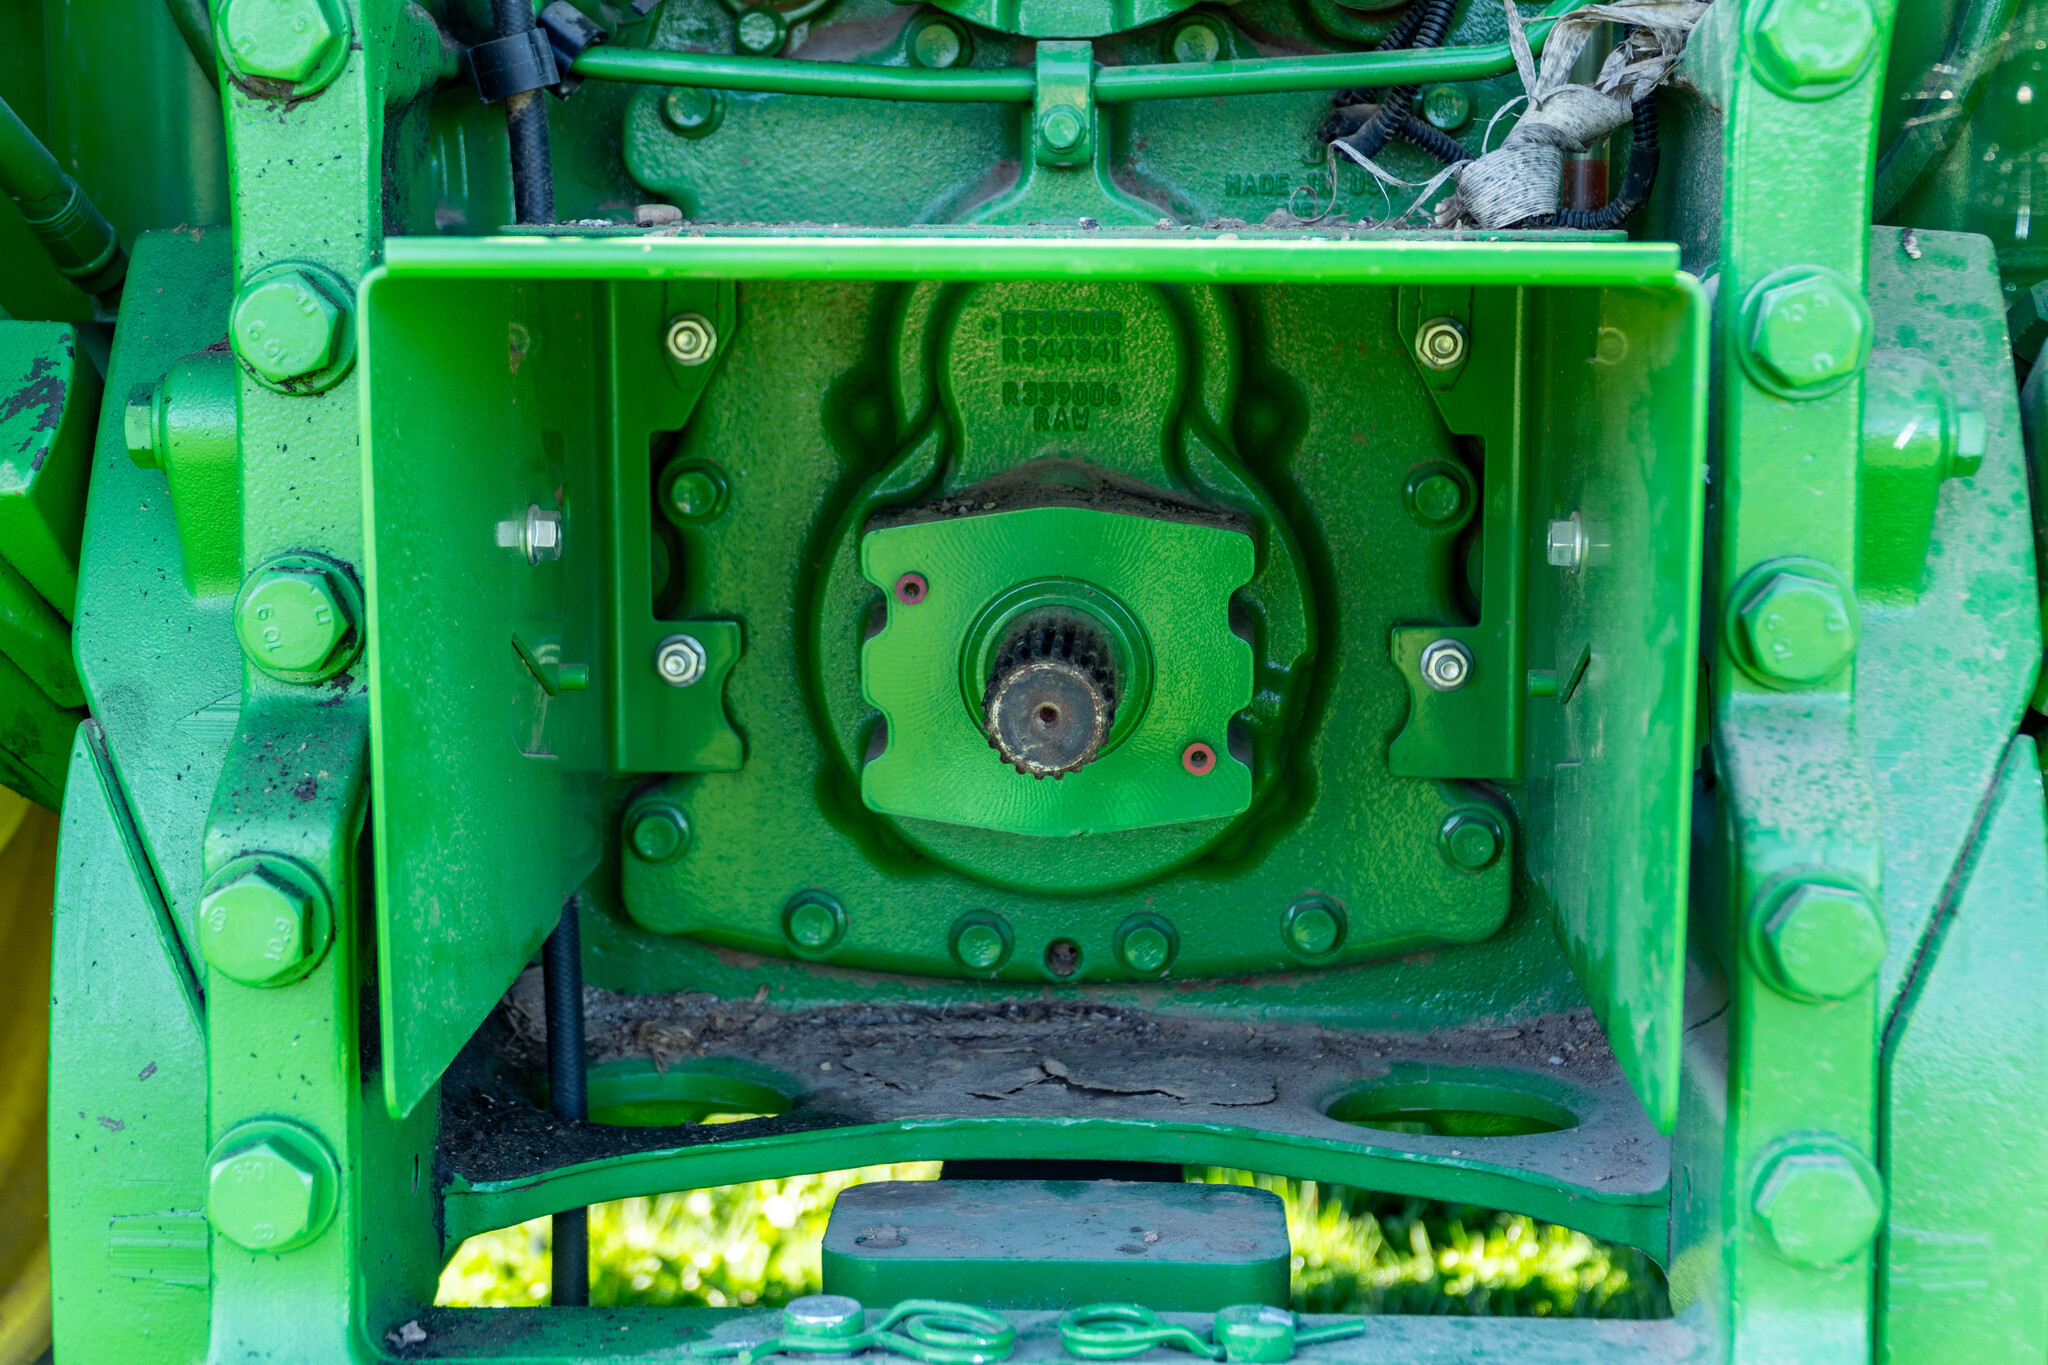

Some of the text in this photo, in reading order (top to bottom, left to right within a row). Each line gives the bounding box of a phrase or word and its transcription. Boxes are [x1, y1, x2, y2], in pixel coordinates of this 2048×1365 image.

[1225, 173, 1291, 196] MADE
[1001, 311, 1123, 336] R339005
[1001, 338, 1122, 364] R344341
[1001, 381, 1122, 407] R339006
[1033, 406, 1091, 432] RAW
